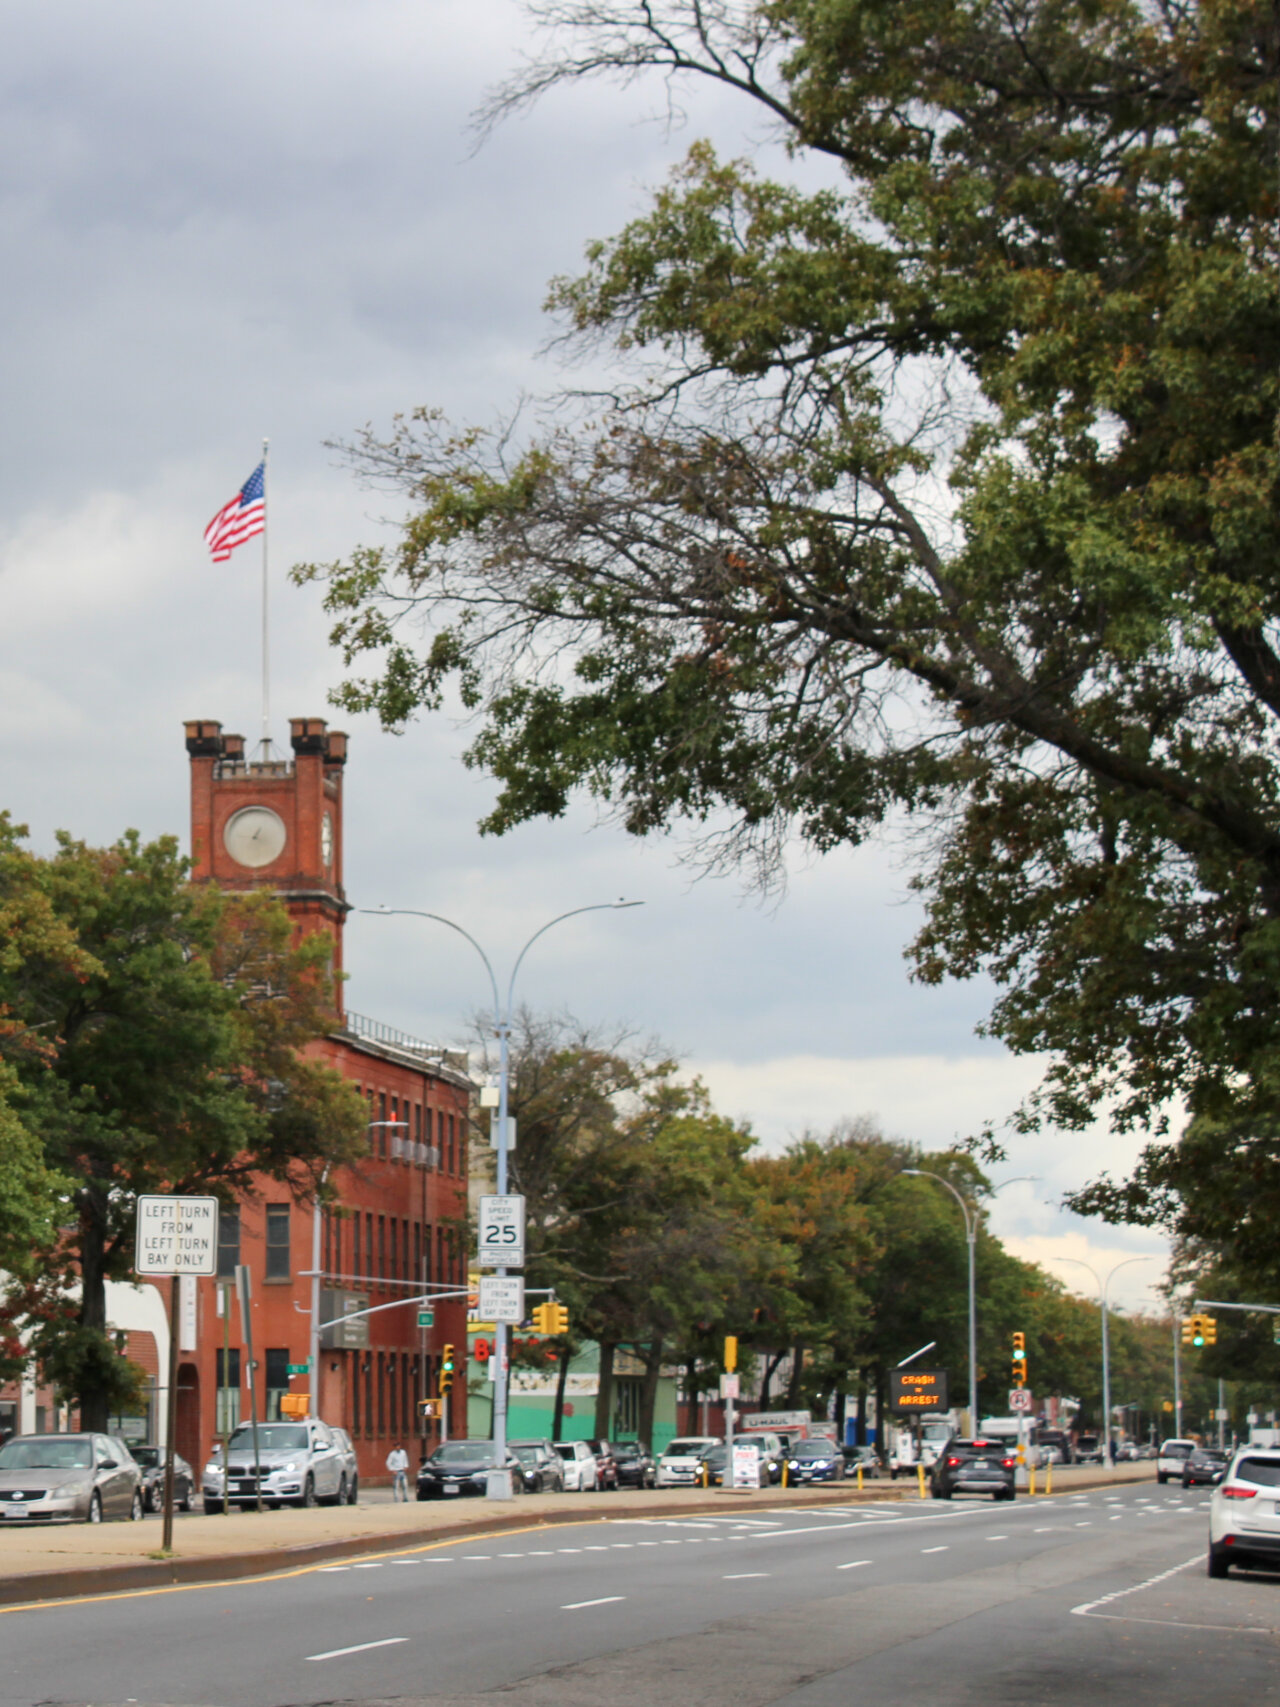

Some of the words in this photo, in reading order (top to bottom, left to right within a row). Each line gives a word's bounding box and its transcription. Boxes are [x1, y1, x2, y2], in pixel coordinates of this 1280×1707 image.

[146, 1205, 173, 1217] LEFT
[180, 1206, 209, 1217] TURN
[161, 1222, 193, 1233] FROM
[486, 1225, 517, 1243] 25
[145, 1237, 173, 1249] LEFT
[178, 1237, 208, 1249] TURN
[147, 1253, 168, 1264] BAY
[174, 1253, 204, 1265] ONLY
[483, 1299, 498, 1307] LEFT
[901, 1375, 936, 1385] CRASH
[899, 1395, 939, 1405] ARREST
